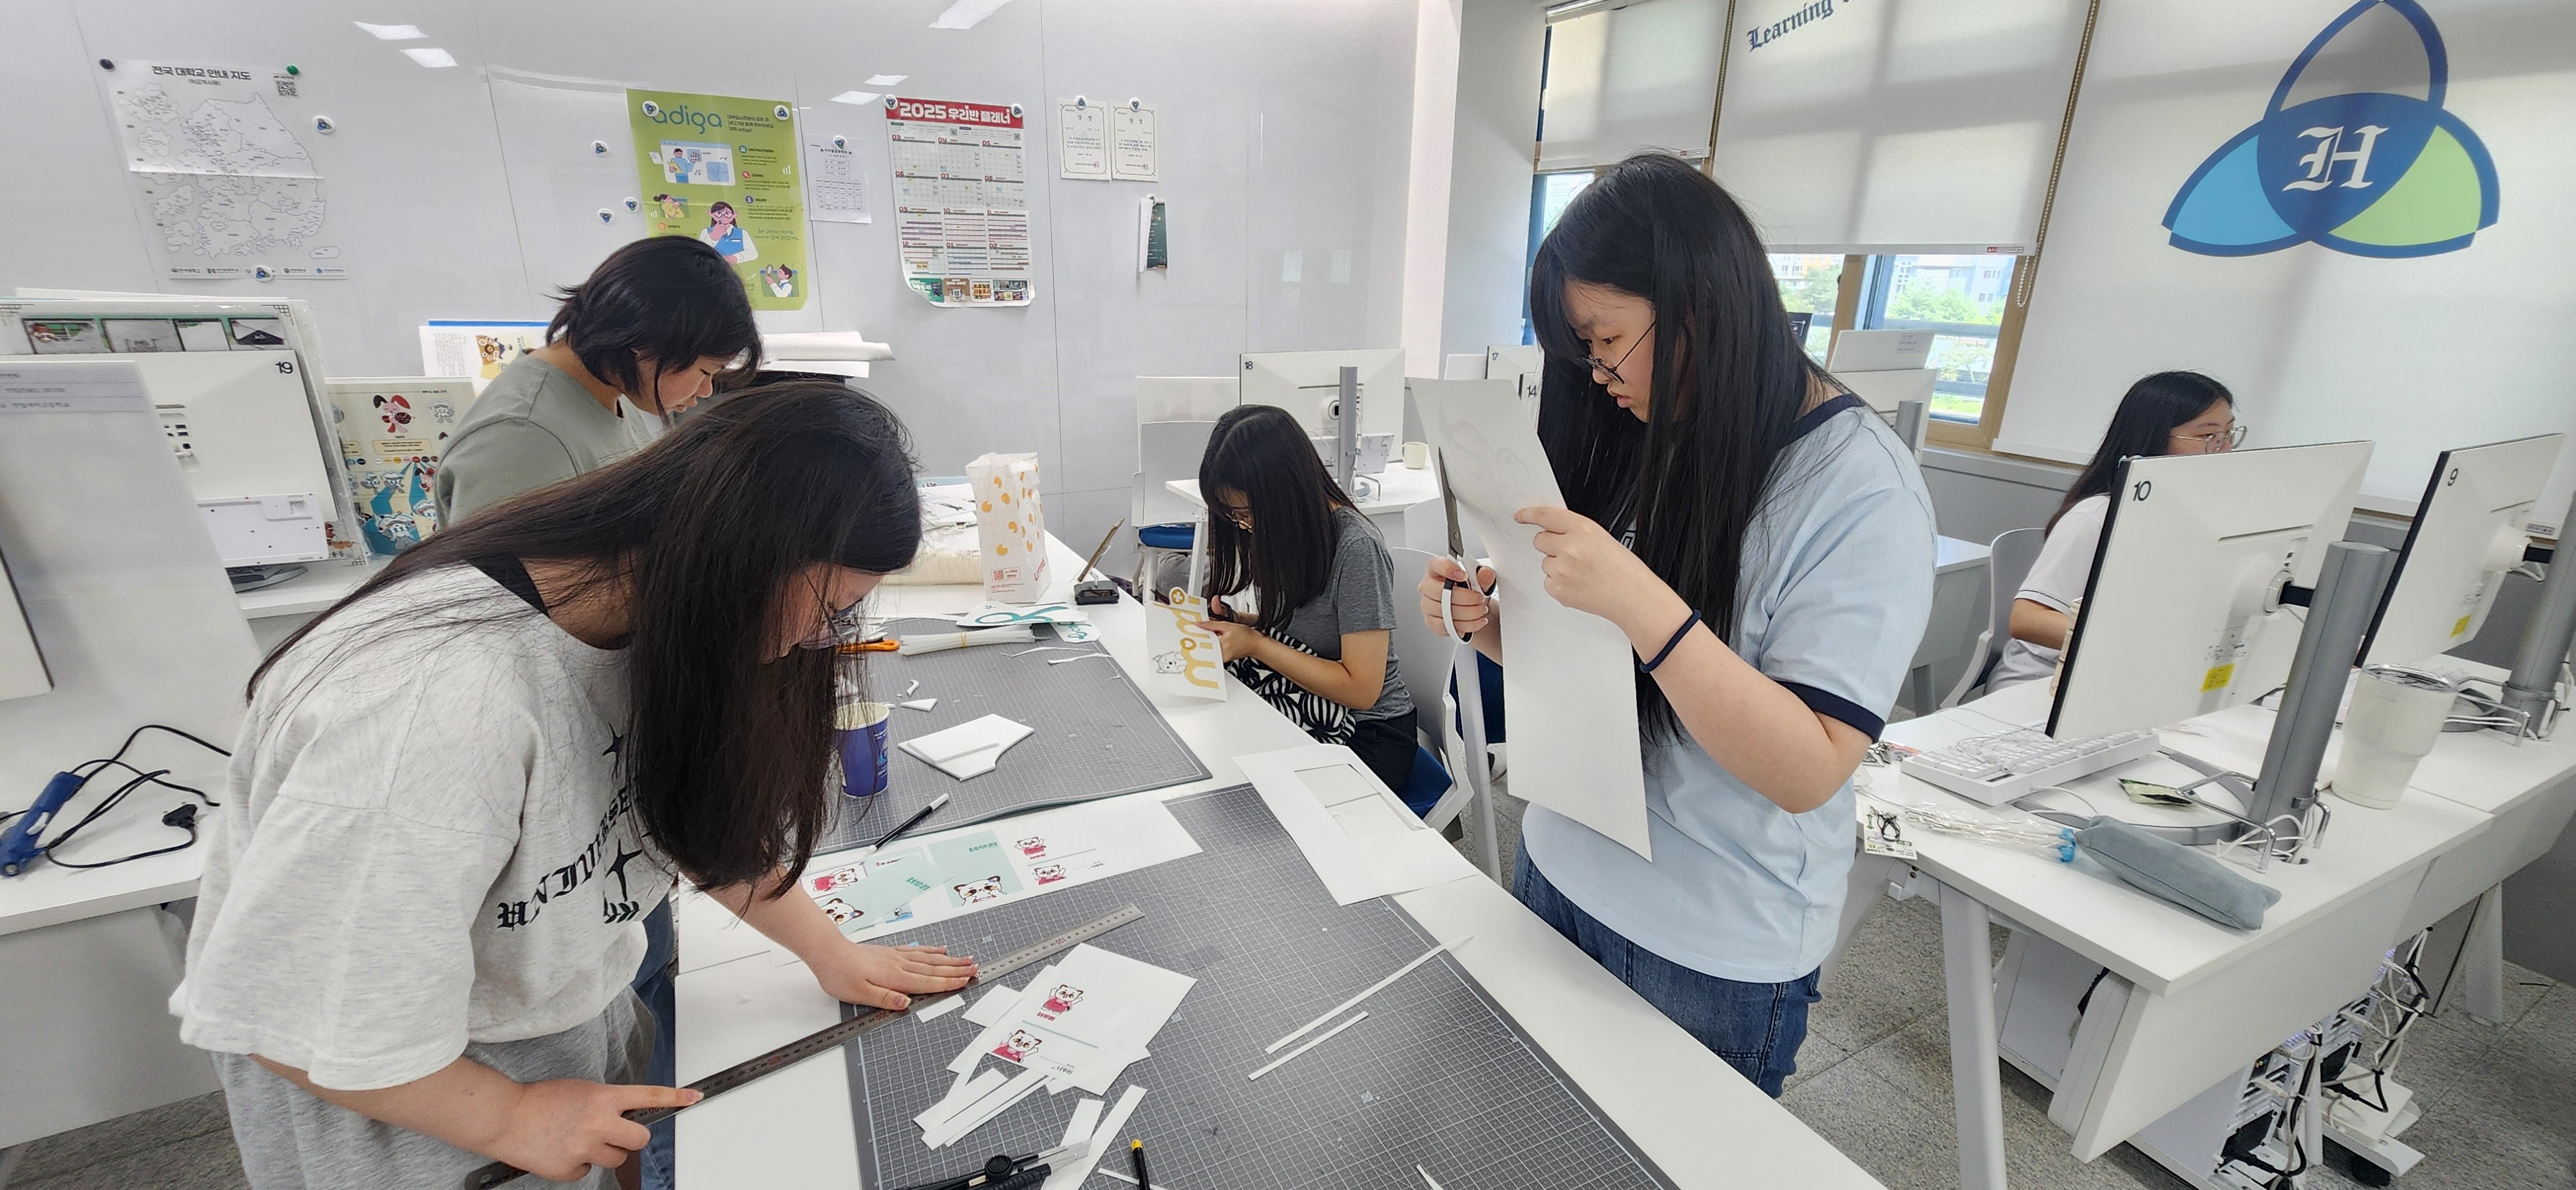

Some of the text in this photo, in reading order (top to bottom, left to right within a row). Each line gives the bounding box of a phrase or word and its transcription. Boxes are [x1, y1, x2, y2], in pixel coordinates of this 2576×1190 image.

[1747, 0, 1834, 52] Learning
[151, 66, 252, 80] 전국 대학교 안내 지도
[652, 105, 723, 134] adiga
[900, 102, 1010, 124] 2025 우리반 플래너
[2282, 125, 2389, 192] H
[1244, 361, 1253, 370] 18
[1492, 352, 1499, 361] 17
[275, 361, 293, 373] 19
[1527, 385, 1537, 397] 14
[2447, 468, 2458, 486] 9
[2132, 480, 2152, 502] 10
